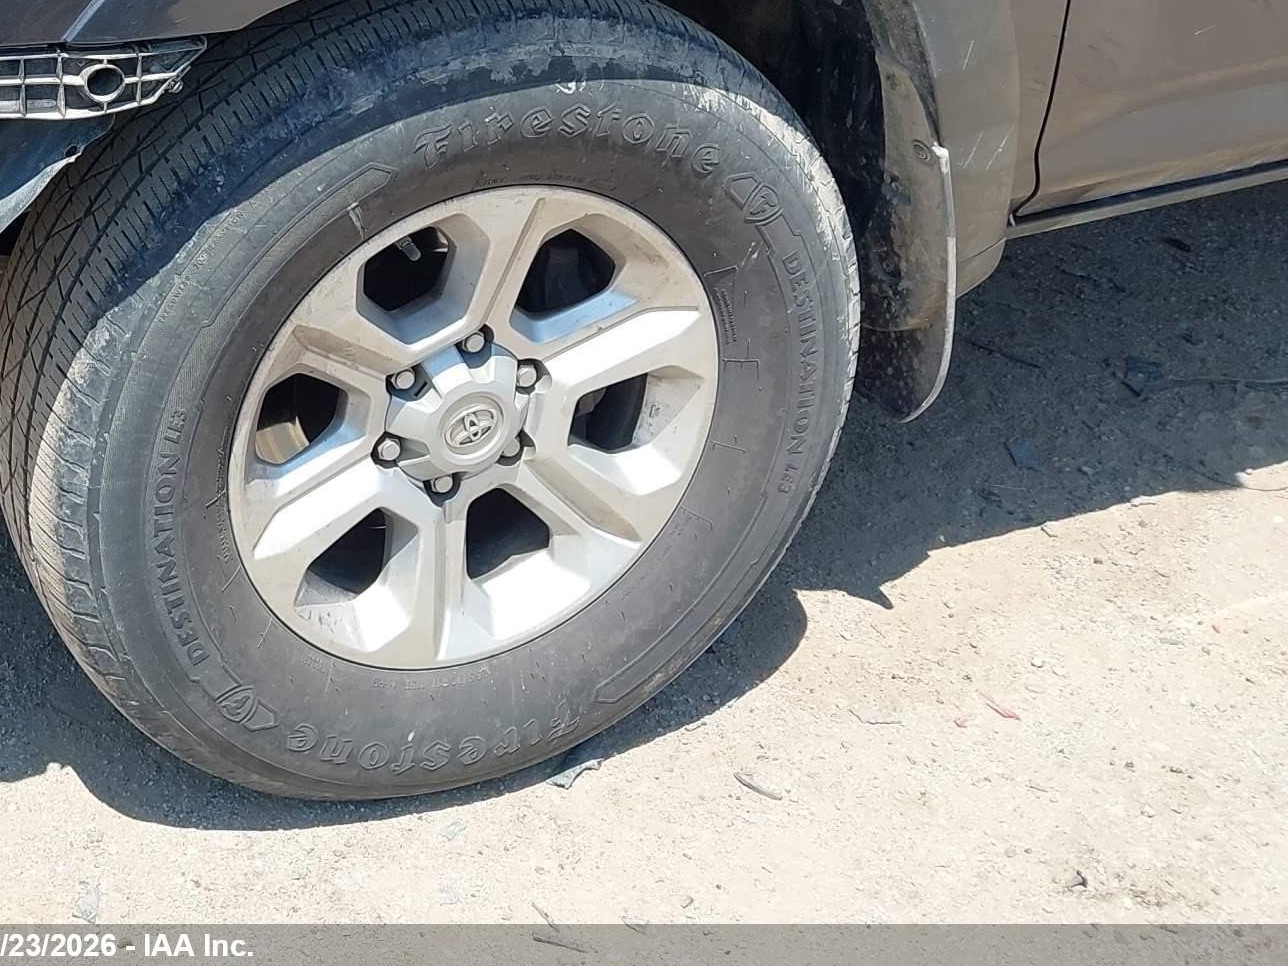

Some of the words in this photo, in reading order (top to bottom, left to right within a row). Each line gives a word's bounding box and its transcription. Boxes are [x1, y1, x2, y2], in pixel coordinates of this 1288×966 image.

[413, 102, 721, 177] Firestone
[781, 250, 817, 455] DESTINATION
[152, 452, 210, 668] DESTINATION
[286, 698, 583, 775] Firestone
